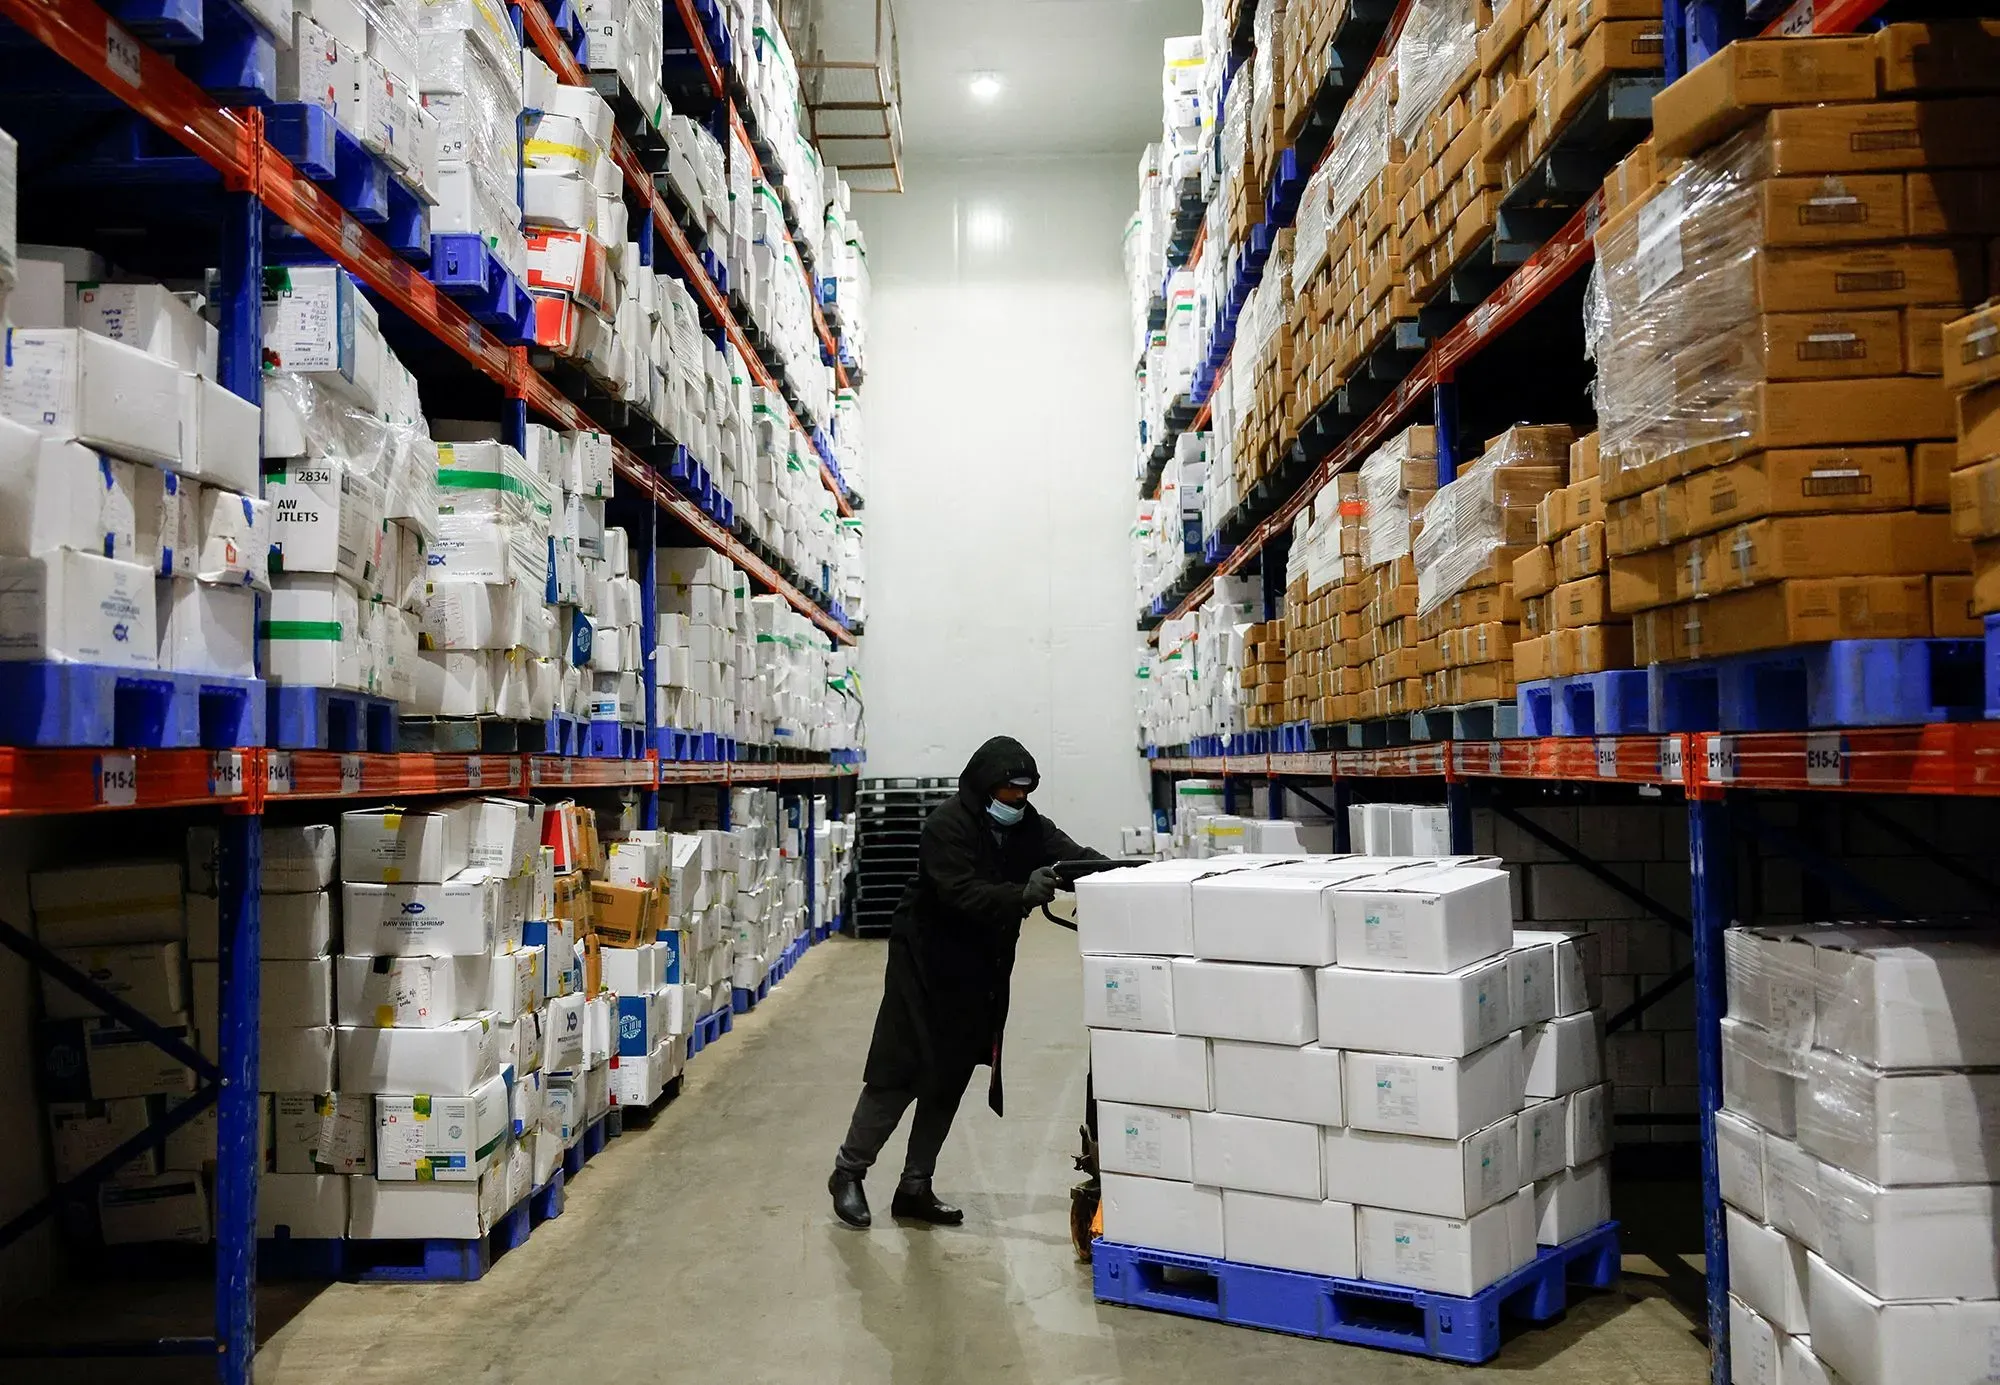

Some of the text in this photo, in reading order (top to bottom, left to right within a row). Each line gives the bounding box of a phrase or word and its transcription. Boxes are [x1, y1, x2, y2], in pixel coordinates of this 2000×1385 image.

[298, 471, 329, 482] 2834
[1662, 752, 1682, 767] E14-1
[1709, 751, 1733, 768] E15-1
[1807, 751, 1840, 769] E15-2
[104, 771, 135, 789] F15-2
[216, 766, 241, 782] F15-1
